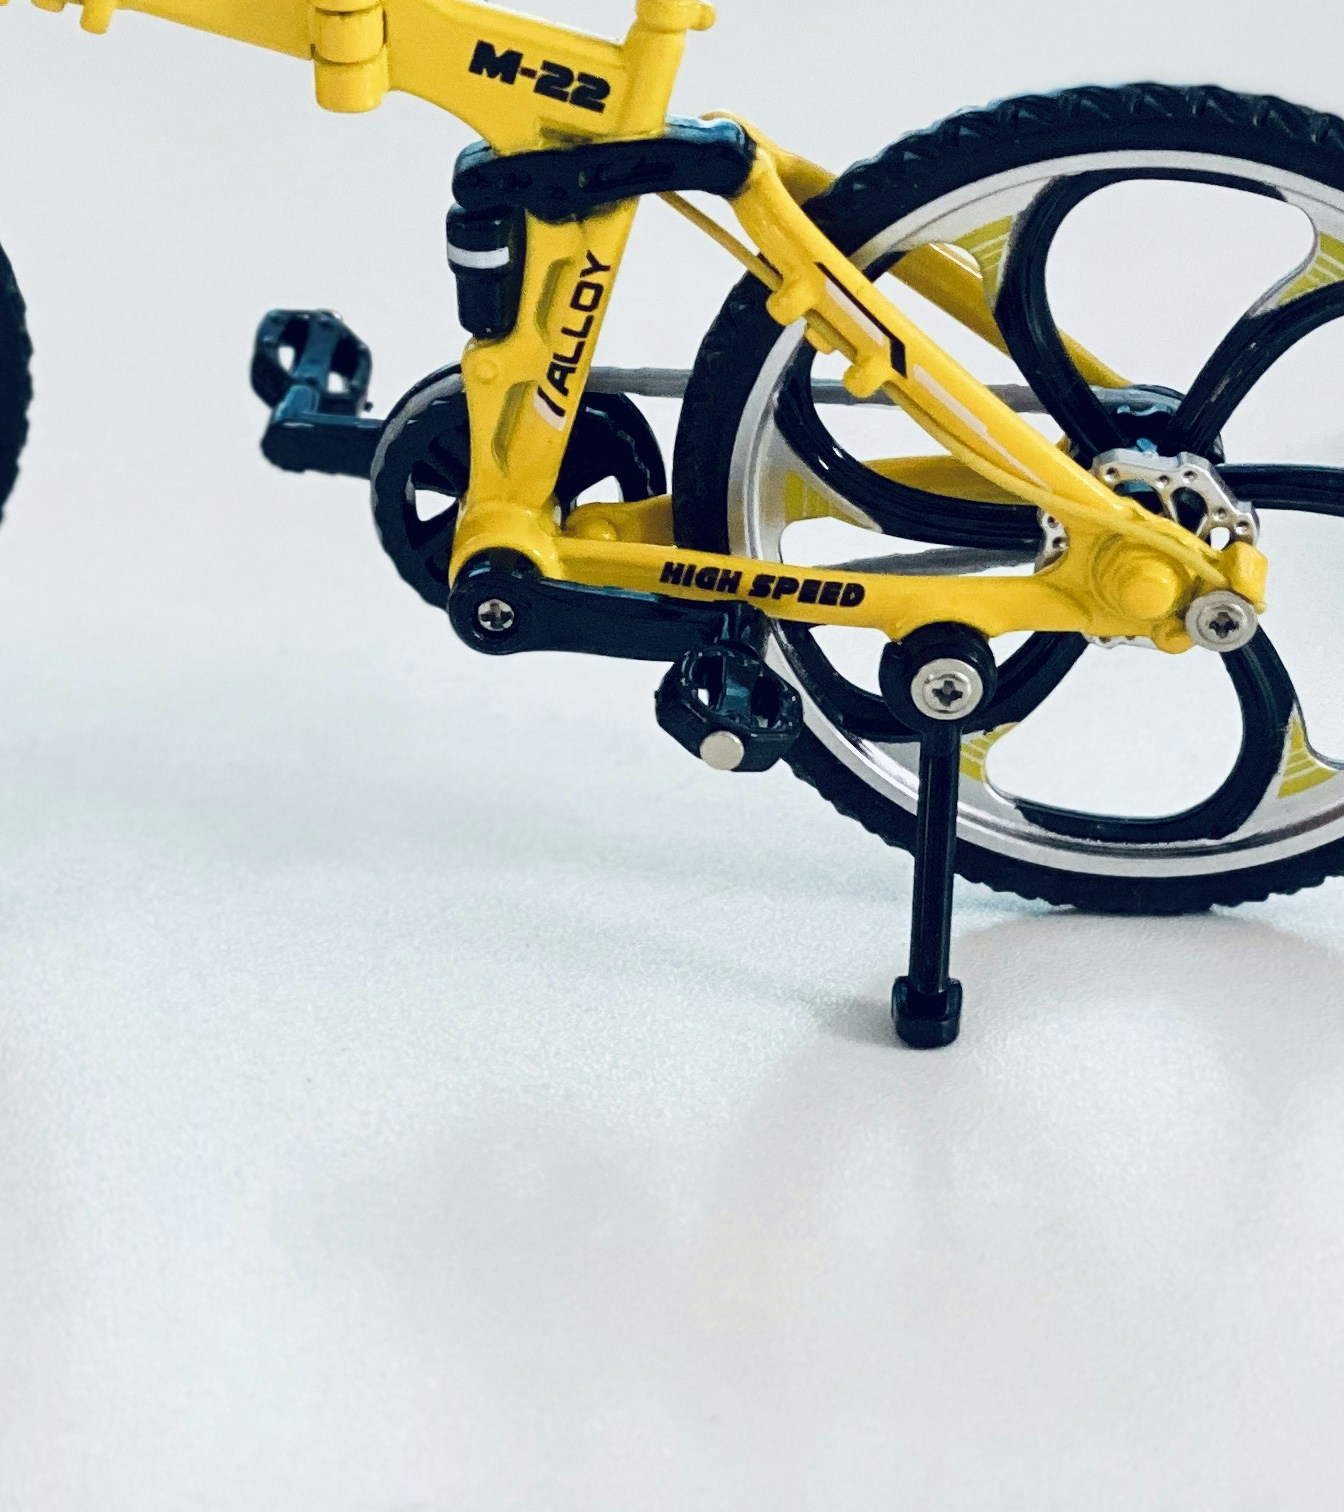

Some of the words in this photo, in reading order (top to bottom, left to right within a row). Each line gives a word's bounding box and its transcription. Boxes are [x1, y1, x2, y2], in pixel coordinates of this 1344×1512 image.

[468, 40, 611, 113] M-22
[546, 249, 611, 396] ALLOY
[659, 561, 743, 594] HIGH
[748, 574, 865, 607] SPEED
